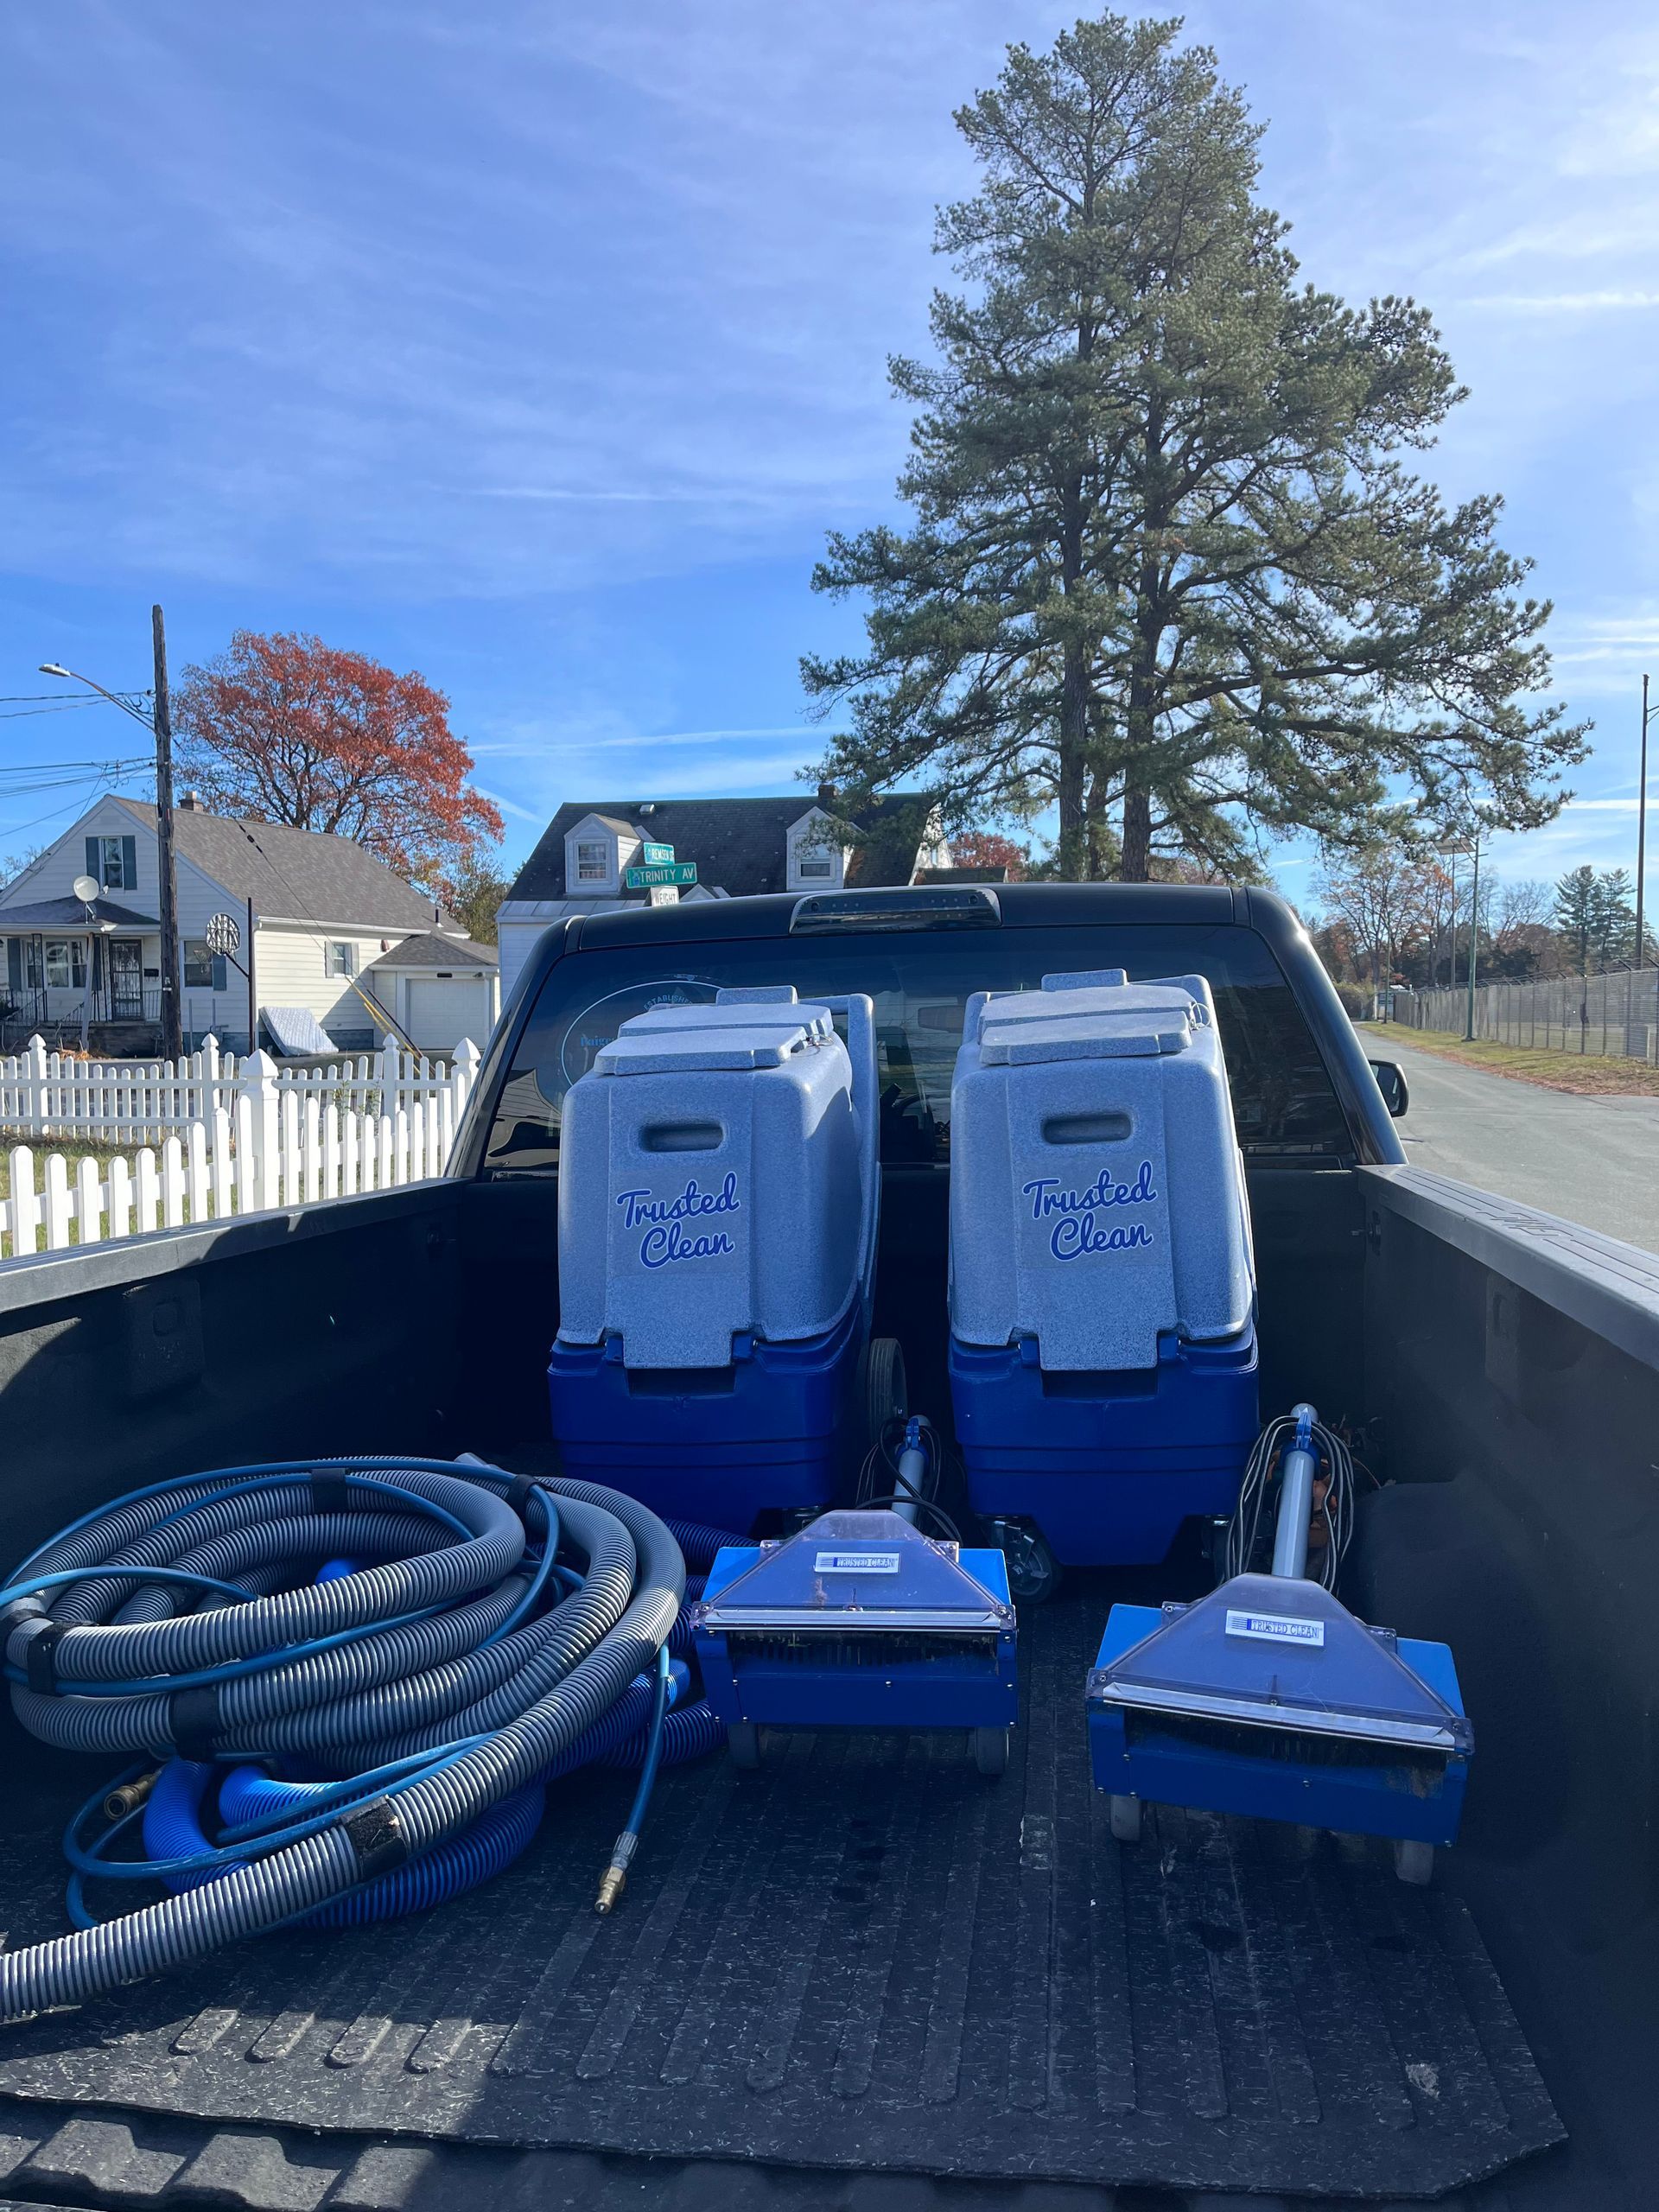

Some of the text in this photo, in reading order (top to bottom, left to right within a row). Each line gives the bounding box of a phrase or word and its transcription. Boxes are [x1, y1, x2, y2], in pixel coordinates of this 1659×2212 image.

[639, 868, 694, 882] TRINITY AV
[617, 1172, 741, 1228] Trusted
[1023, 1160, 1158, 1219] Trusted
[640, 1221, 734, 1268] Clean
[1051, 1211, 1153, 1261] Clean
[836, 1557, 894, 1567] TRUSTED CLEAN
[1252, 1619, 1319, 1638] TRUSTED CLEAN
